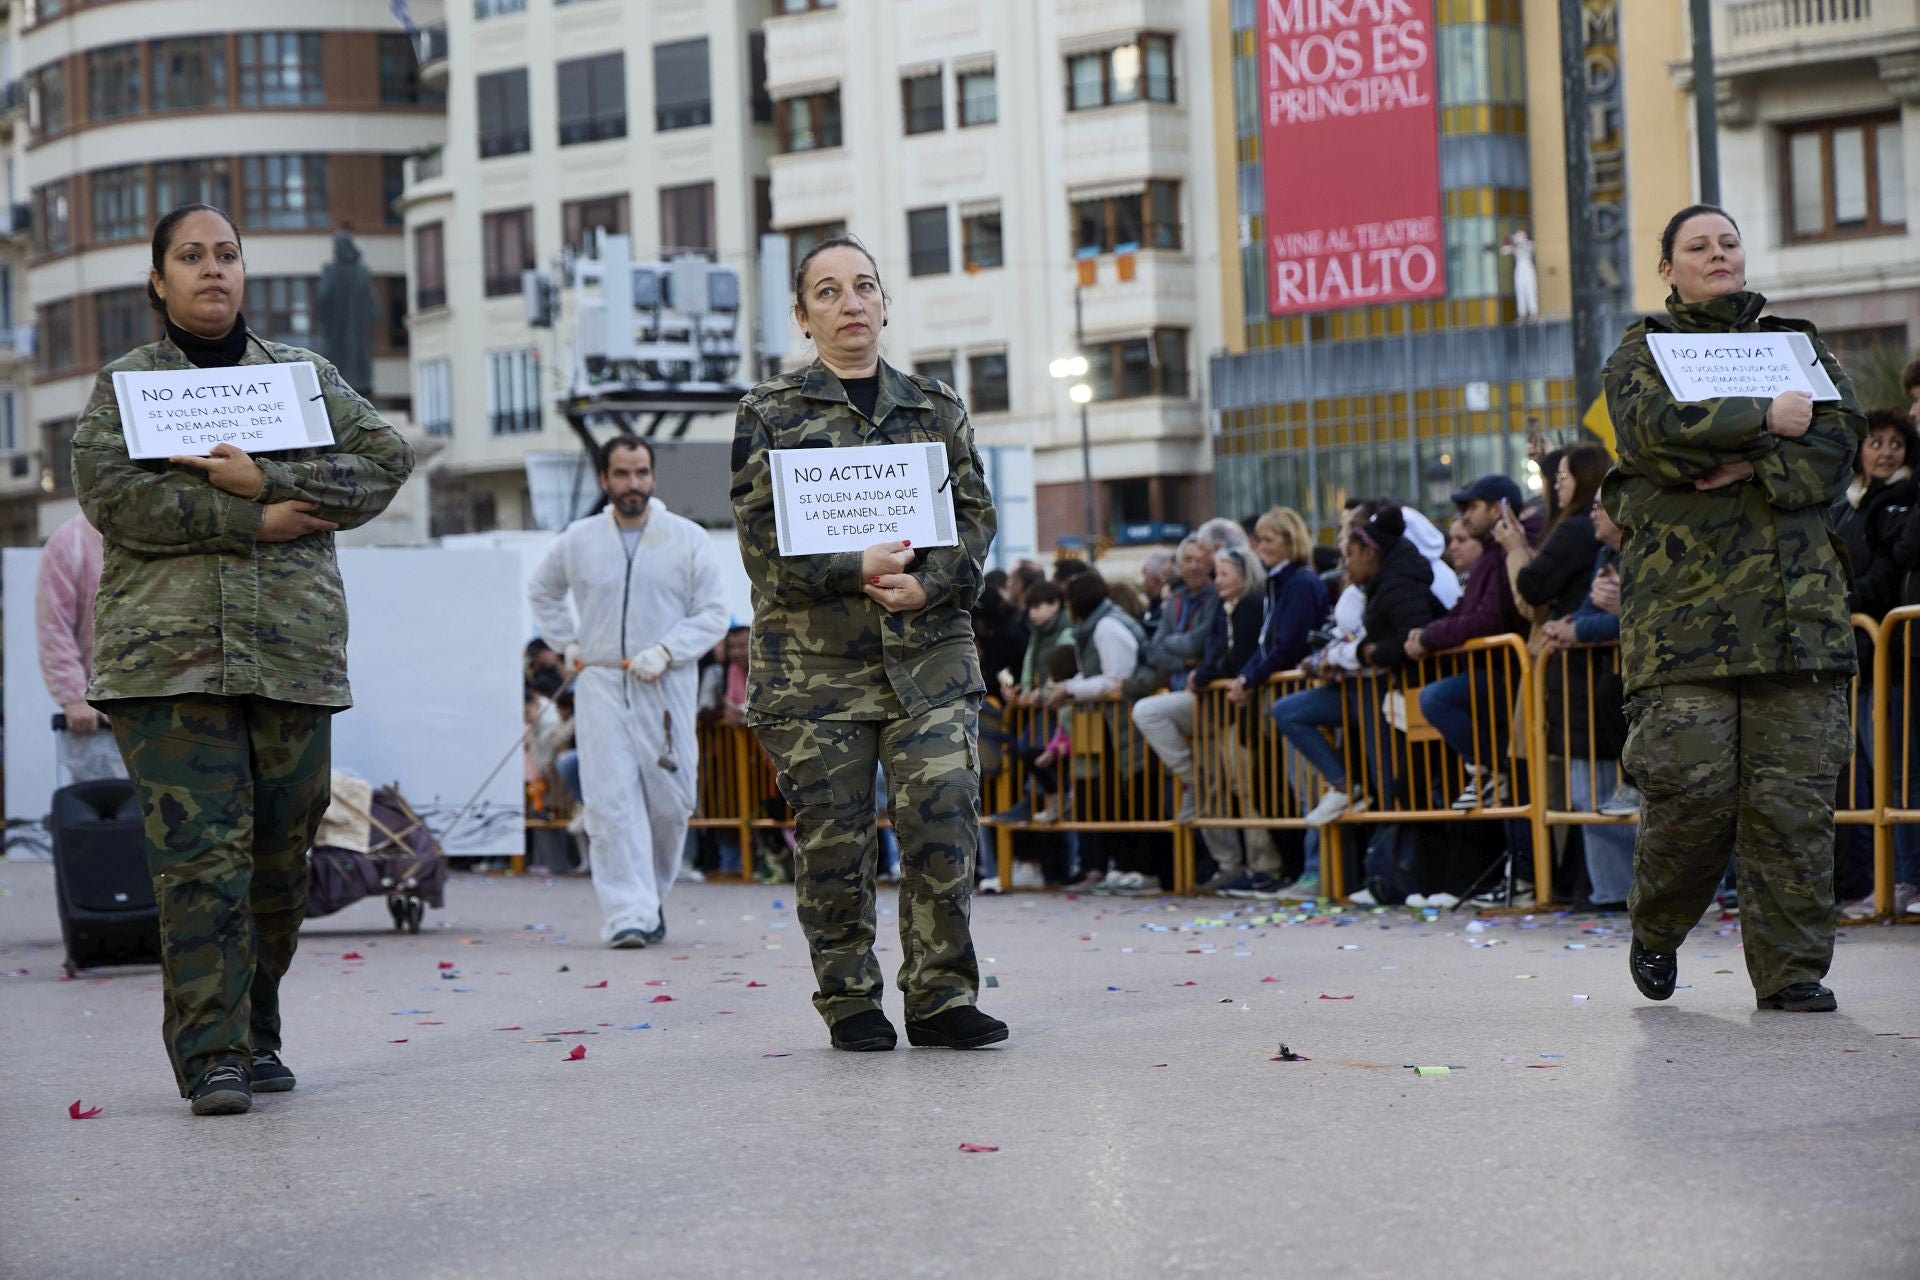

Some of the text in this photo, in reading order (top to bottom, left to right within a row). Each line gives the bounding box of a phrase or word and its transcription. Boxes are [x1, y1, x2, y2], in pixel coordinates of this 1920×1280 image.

[1268, 30, 1363, 88] NOS
[1269, 70, 1430, 126] PRINCIPAL
[1273, 215, 1437, 258] VINE AL TEATRE
[1277, 244, 1436, 306] RIALTO
[1672, 348, 1774, 359] NO ACTIVAT
[1697, 365, 1729, 373] VOLEN
[1769, 364, 1792, 372] QUE
[142, 382, 272, 401] NO ACTIVAT
[149, 402, 284, 418] SI VOLEN AJUDA QUE
[157, 423, 171, 432] LA
[251, 416, 282, 425] DEIA
[182, 436, 196, 444] EL
[242, 431, 263, 440] IXE
[795, 463, 908, 483] NO ACTIVAT
[800, 488, 918, 504] SI VOLEN AJUDA QUE
[806, 511, 819, 520] LA
[888, 506, 915, 516] DEIA
[828, 526, 839, 535] EL
[879, 523, 898, 532] IXE
